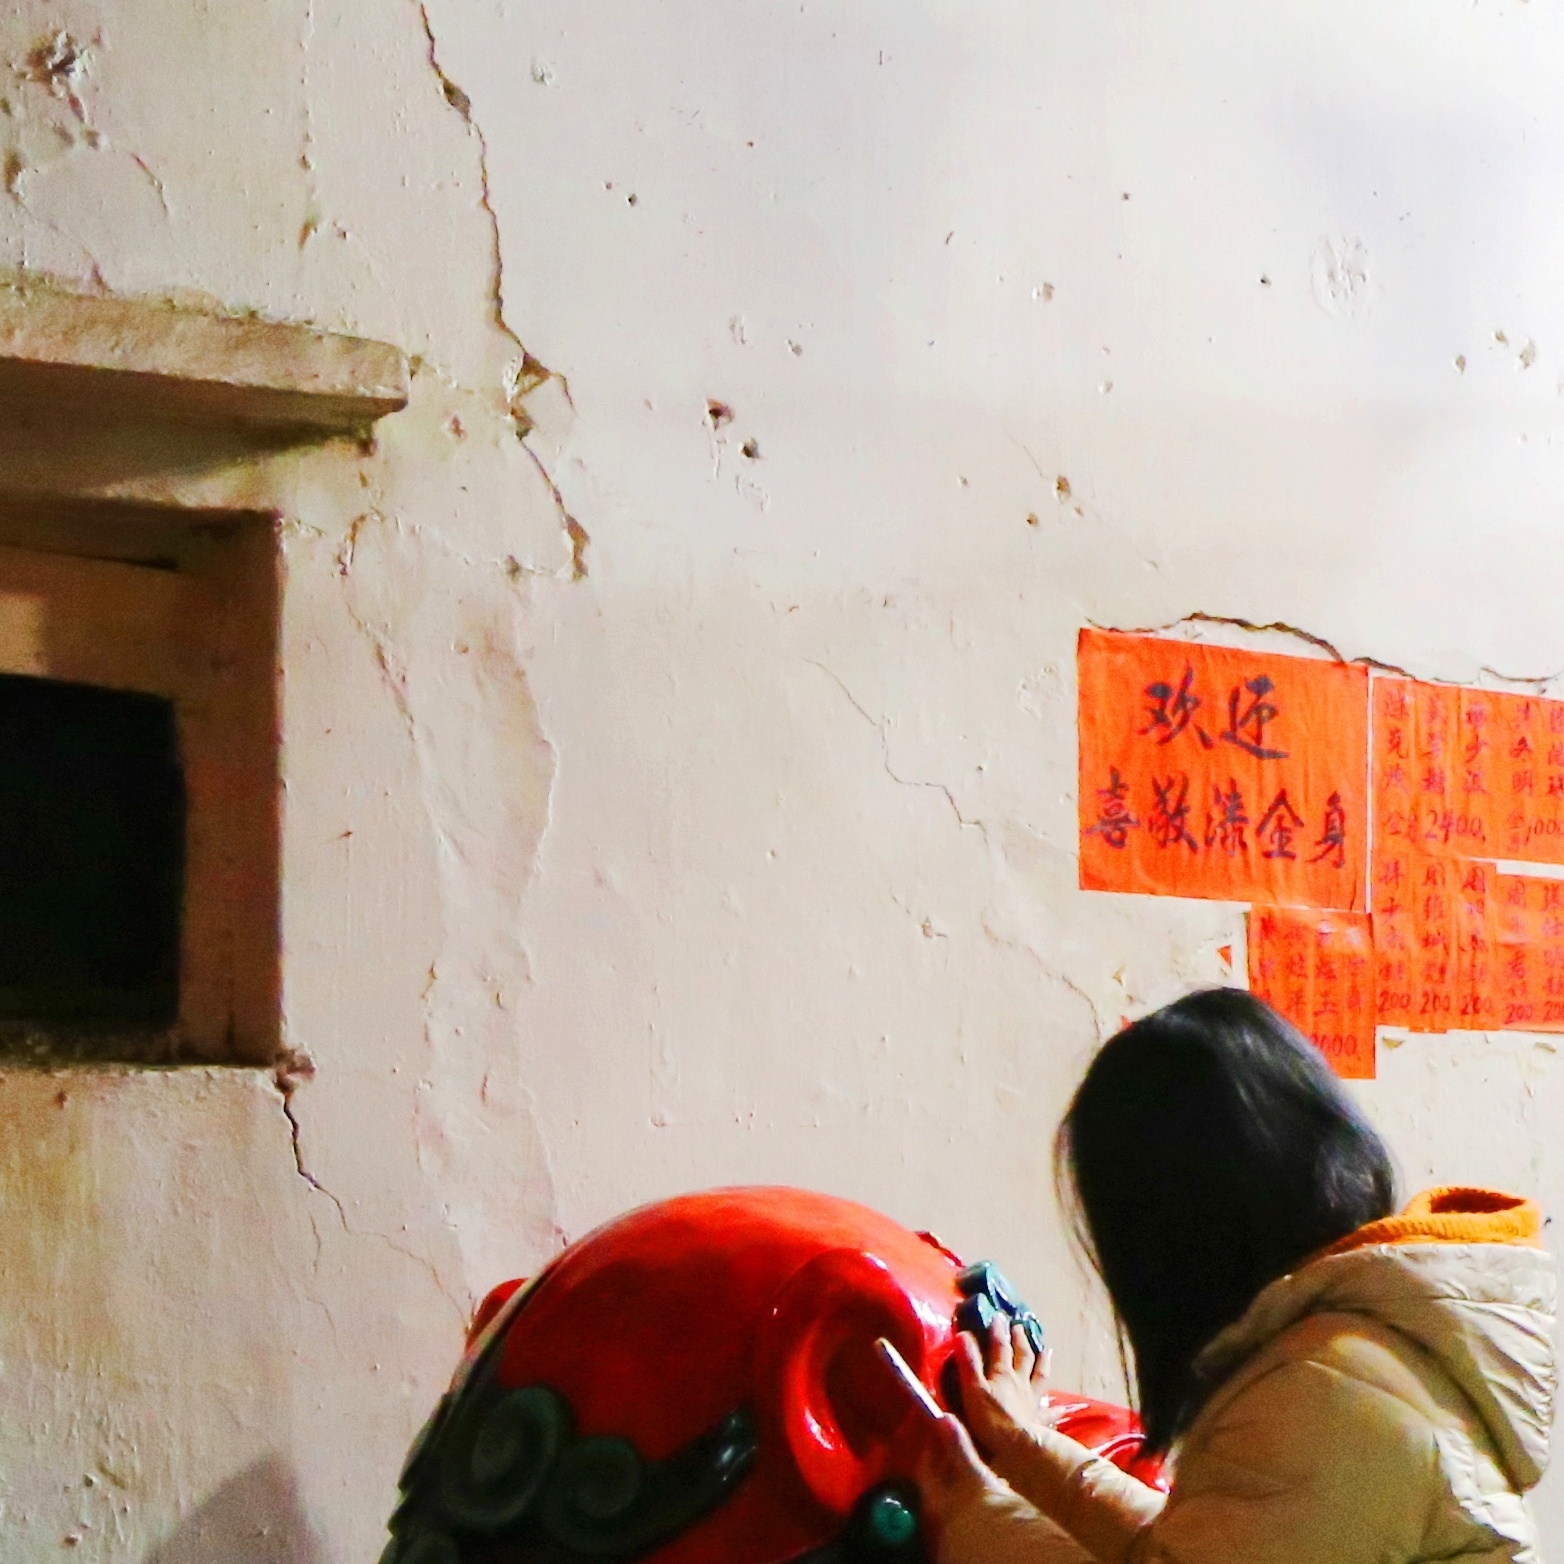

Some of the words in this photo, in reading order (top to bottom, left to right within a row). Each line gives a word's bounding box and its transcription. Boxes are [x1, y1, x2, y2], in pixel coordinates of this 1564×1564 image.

[1139, 659, 1290, 760] 欢迎
[1377, 990, 1411, 1014] 200
[1419, 989, 1451, 1015] 200
[1504, 1003, 1533, 1025] 200
